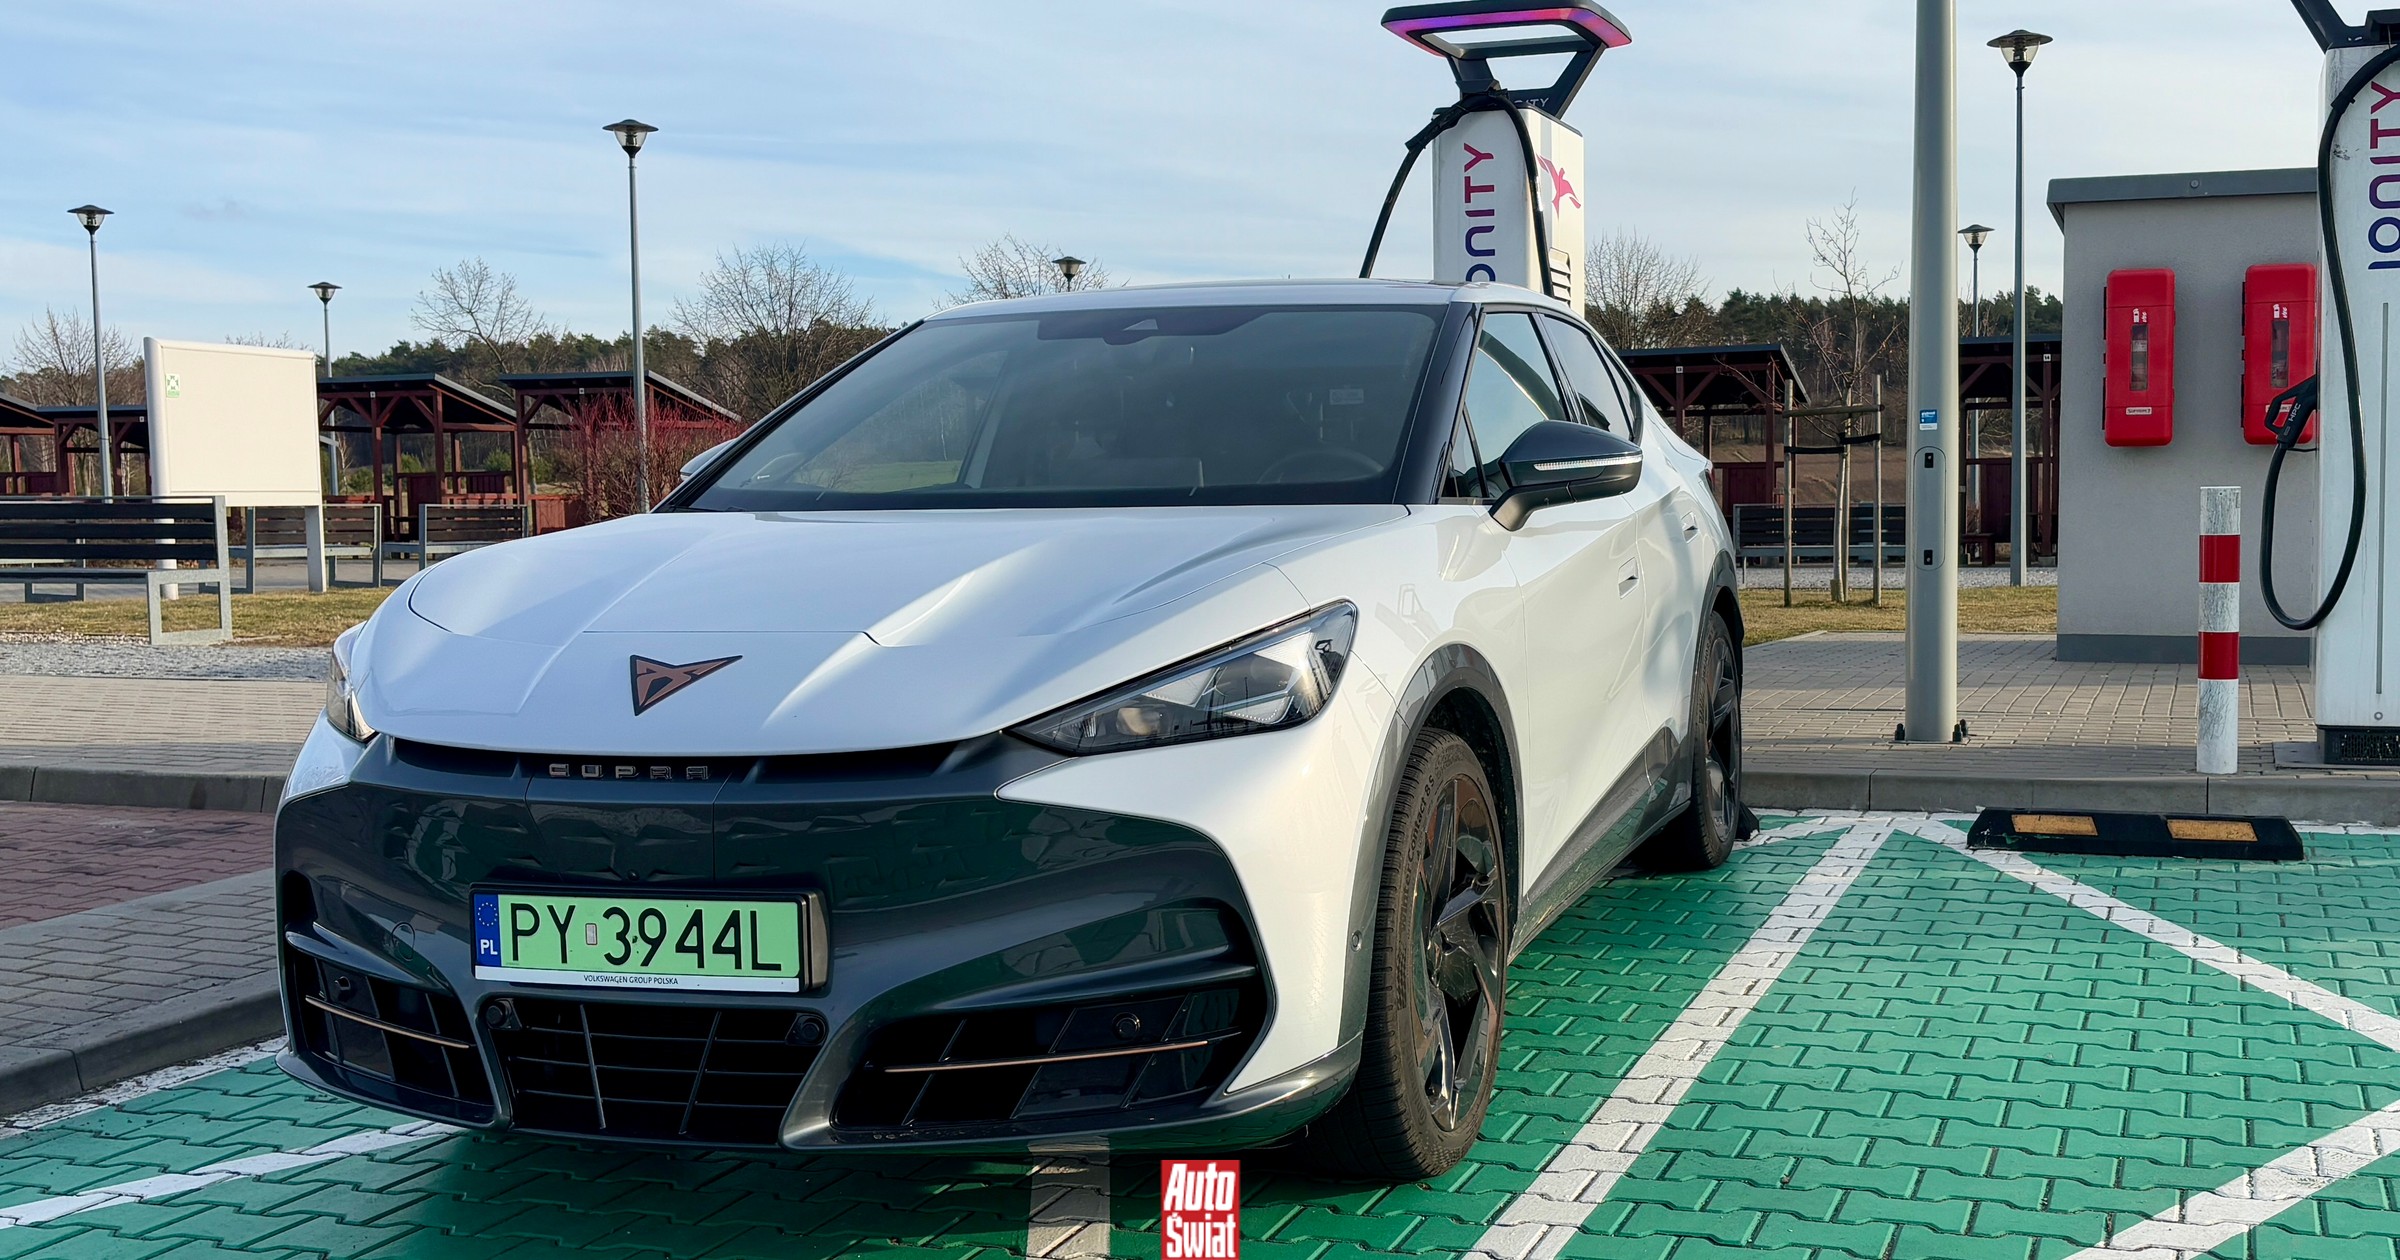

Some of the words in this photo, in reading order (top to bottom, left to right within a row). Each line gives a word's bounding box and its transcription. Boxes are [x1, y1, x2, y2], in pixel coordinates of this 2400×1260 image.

[2367, 81, 2400, 270] IONITY
[1463, 142, 1496, 282] ONITY
[2288, 402, 2301, 422] HPC
[549, 763, 709, 780] CUPRA
[480, 939, 498, 955] PL
[510, 902, 576, 965] PY
[602, 906, 782, 972] 3944L
[583, 974, 628, 984] VOLKSWAGEN
[628, 976, 653, 984] GROUP
[653, 977, 679, 985] POLSKA
